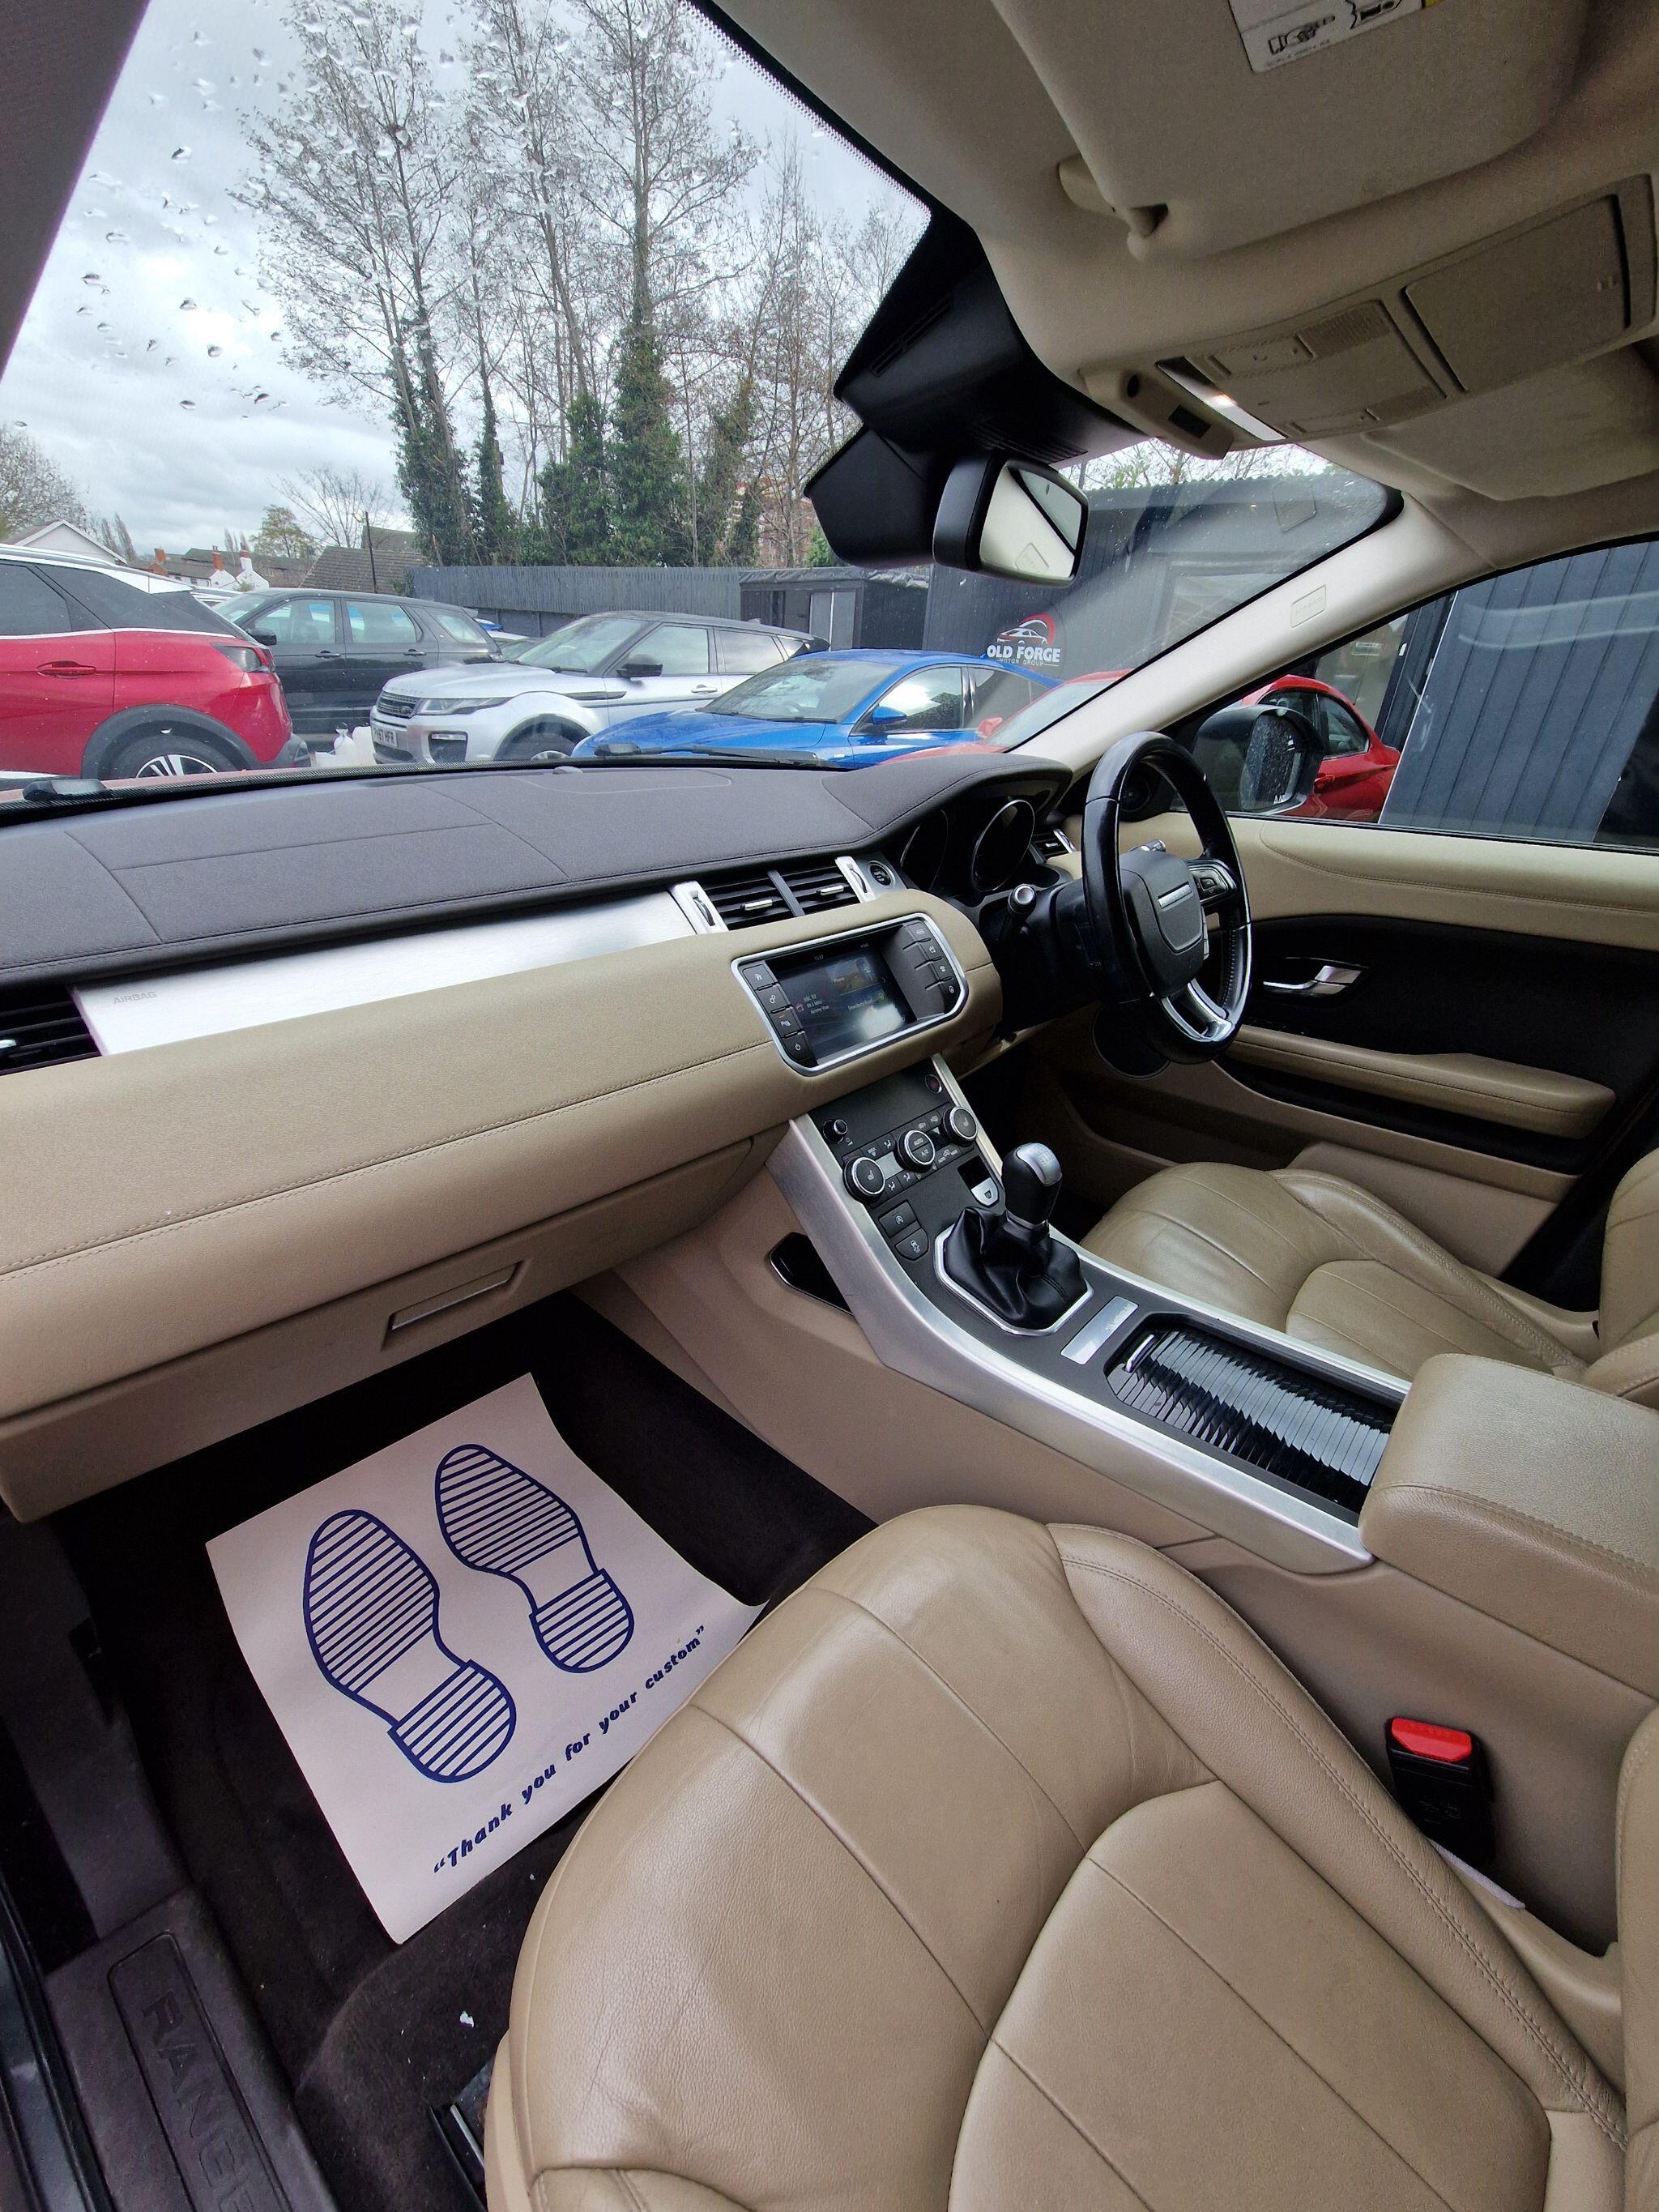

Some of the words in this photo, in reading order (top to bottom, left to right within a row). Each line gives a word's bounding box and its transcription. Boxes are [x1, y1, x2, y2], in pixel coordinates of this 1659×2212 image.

[987, 645, 1013, 658] OLD
[1017, 647, 1060, 662] FORGE
[114, 991, 156, 1004] AIRBAG
[914, 1138, 923, 1146] AUTO
[522, 1765, 557, 1804] you
[565, 1733, 591, 1761] for
[599, 1692, 638, 1734] your
